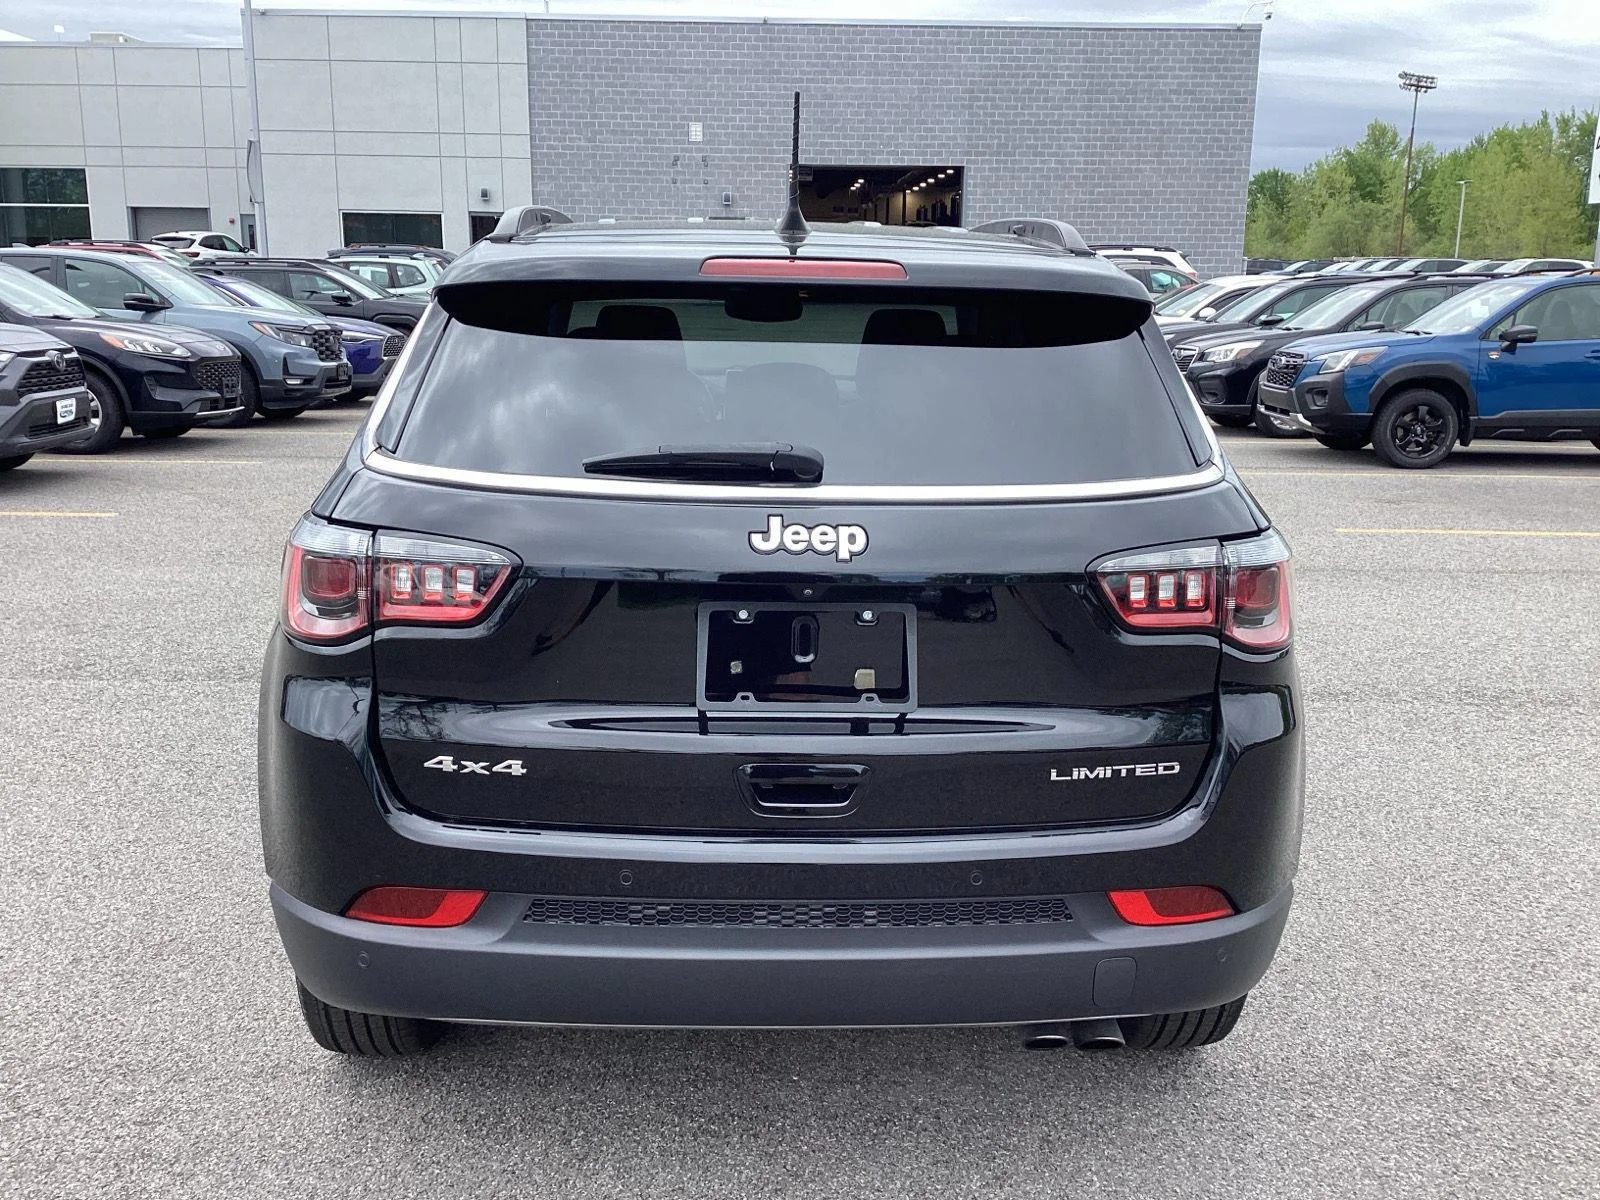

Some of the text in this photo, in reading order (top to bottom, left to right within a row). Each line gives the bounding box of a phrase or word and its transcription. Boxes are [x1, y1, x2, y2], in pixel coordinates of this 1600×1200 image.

[749, 514, 869, 561] Jeep
[423, 755, 528, 776] 4x4
[1050, 761, 1181, 781] LIMITED
